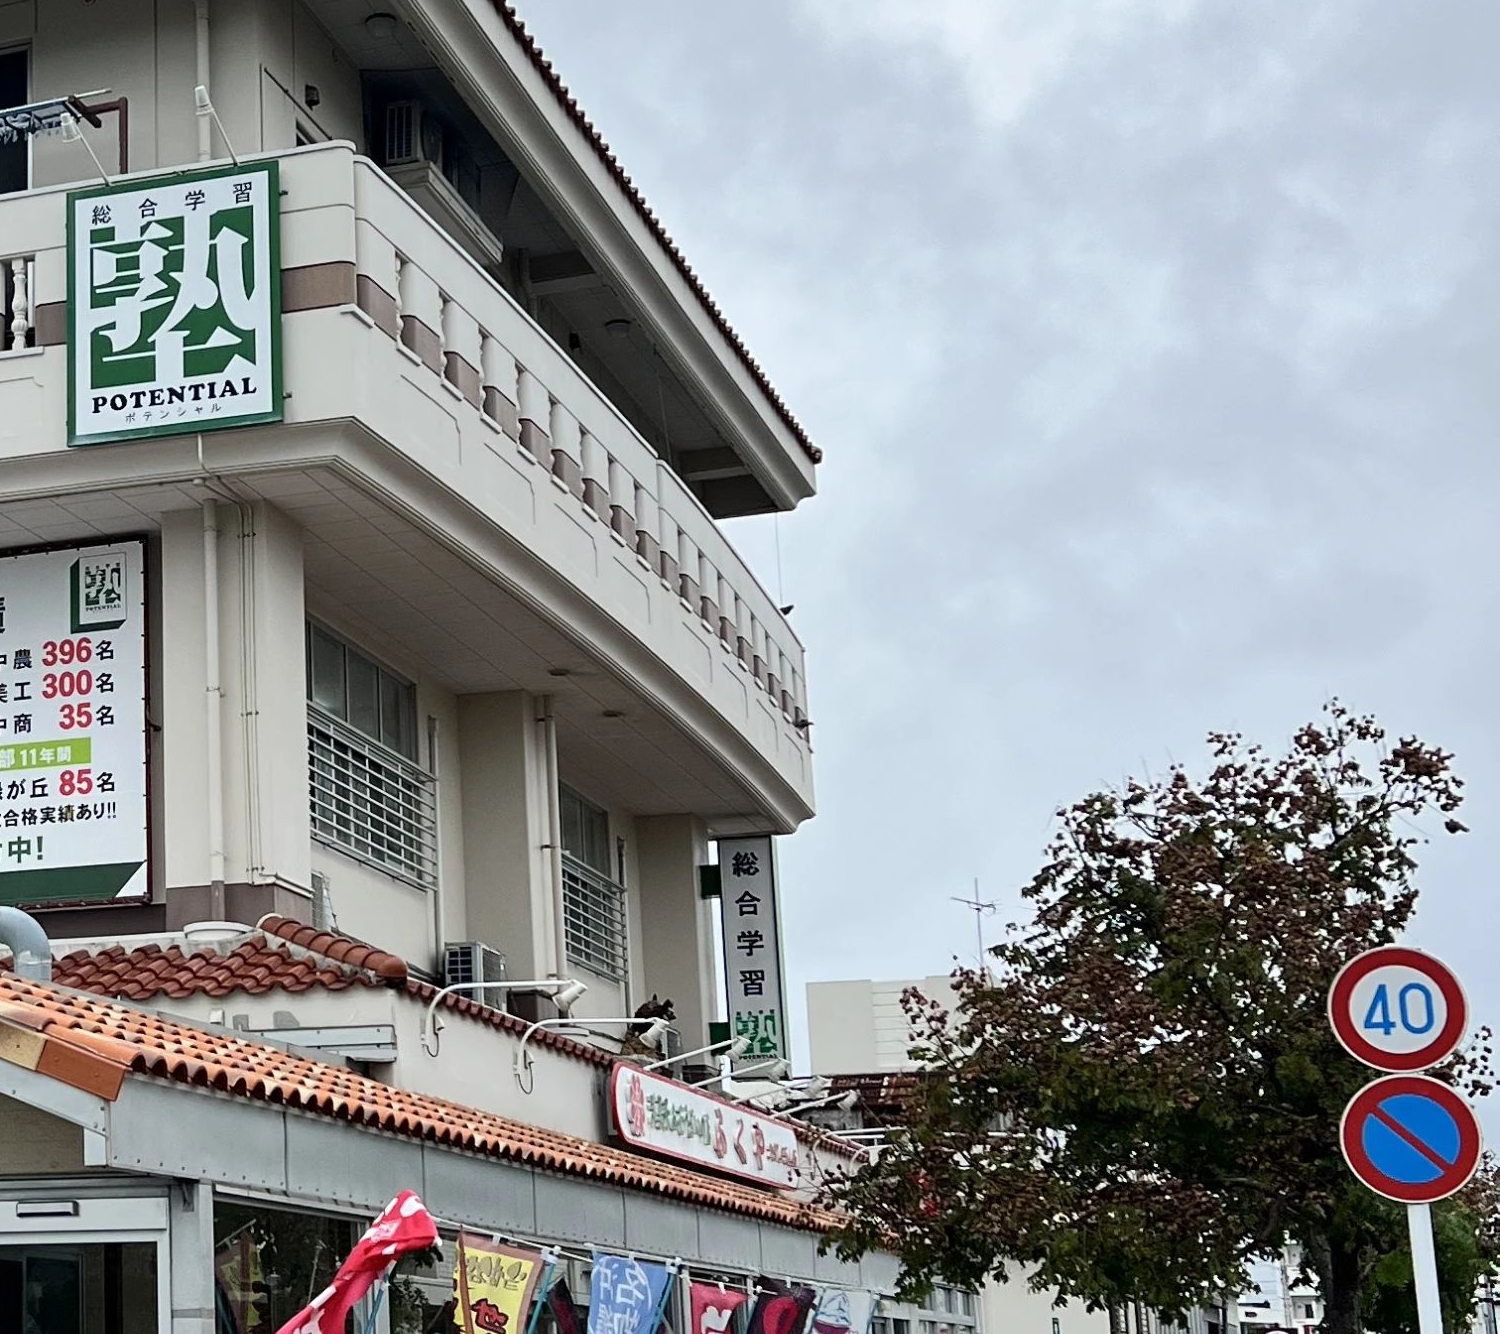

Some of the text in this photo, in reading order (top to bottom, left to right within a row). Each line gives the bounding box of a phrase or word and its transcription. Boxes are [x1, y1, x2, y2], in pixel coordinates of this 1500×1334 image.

[91, 182, 253, 225] 総合学習
[90, 204, 257, 390] 塾
[91, 377, 257, 414] POTENTIAL
[125, 402, 222, 423] ポテンシャル
[41, 636, 115, 667] 396名
[41, 669, 115, 700] 300名
[58, 702, 115, 730] 35名
[58, 768, 116, 796] 85名
[731, 851, 765, 998] 総合学習
[1363, 982, 1435, 1035] 40
